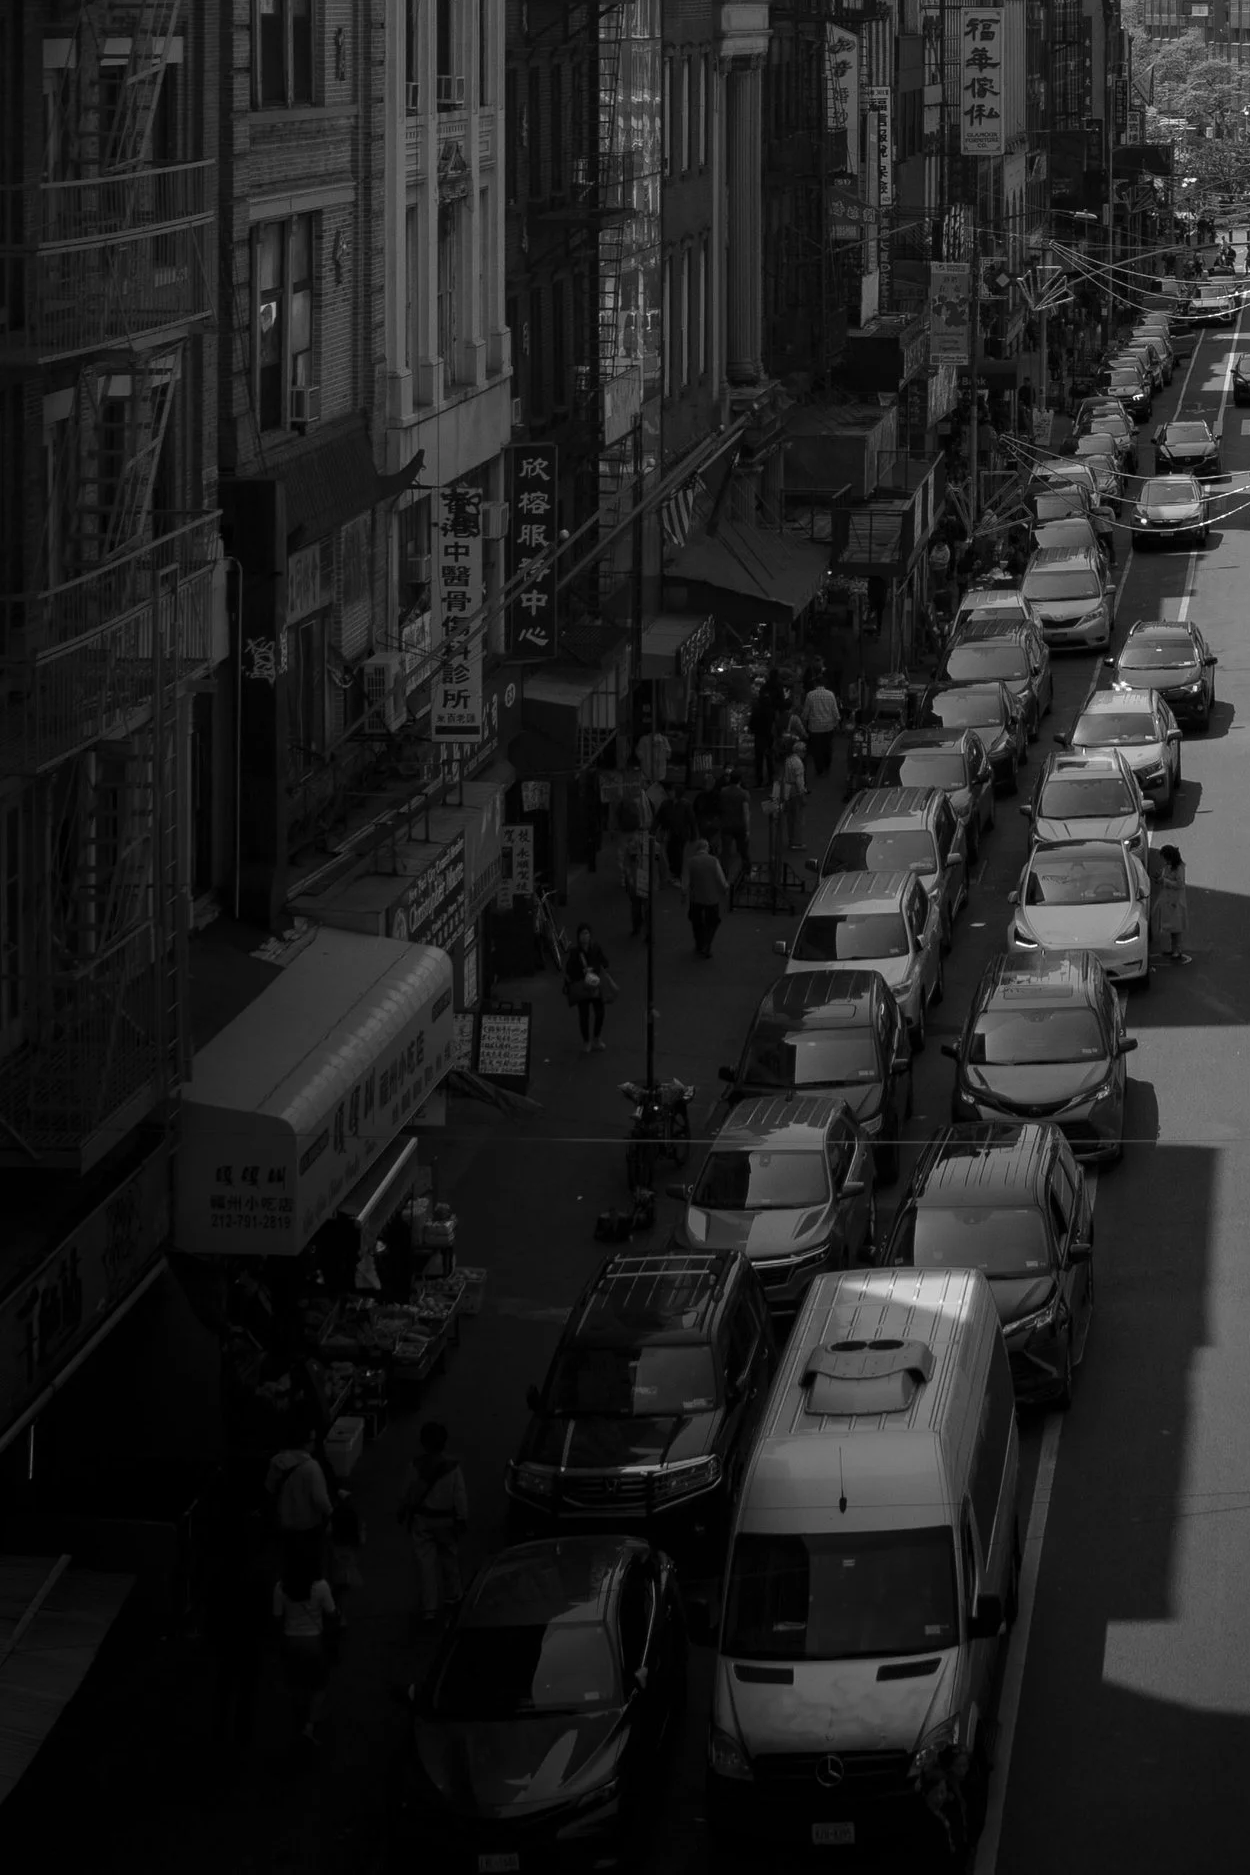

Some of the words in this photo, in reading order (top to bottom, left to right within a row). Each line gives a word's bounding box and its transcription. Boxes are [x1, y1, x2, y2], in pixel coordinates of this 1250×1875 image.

[964, 17, 1001, 126] 福華傢俬
[517, 457, 551, 647] 欣榕服務中心
